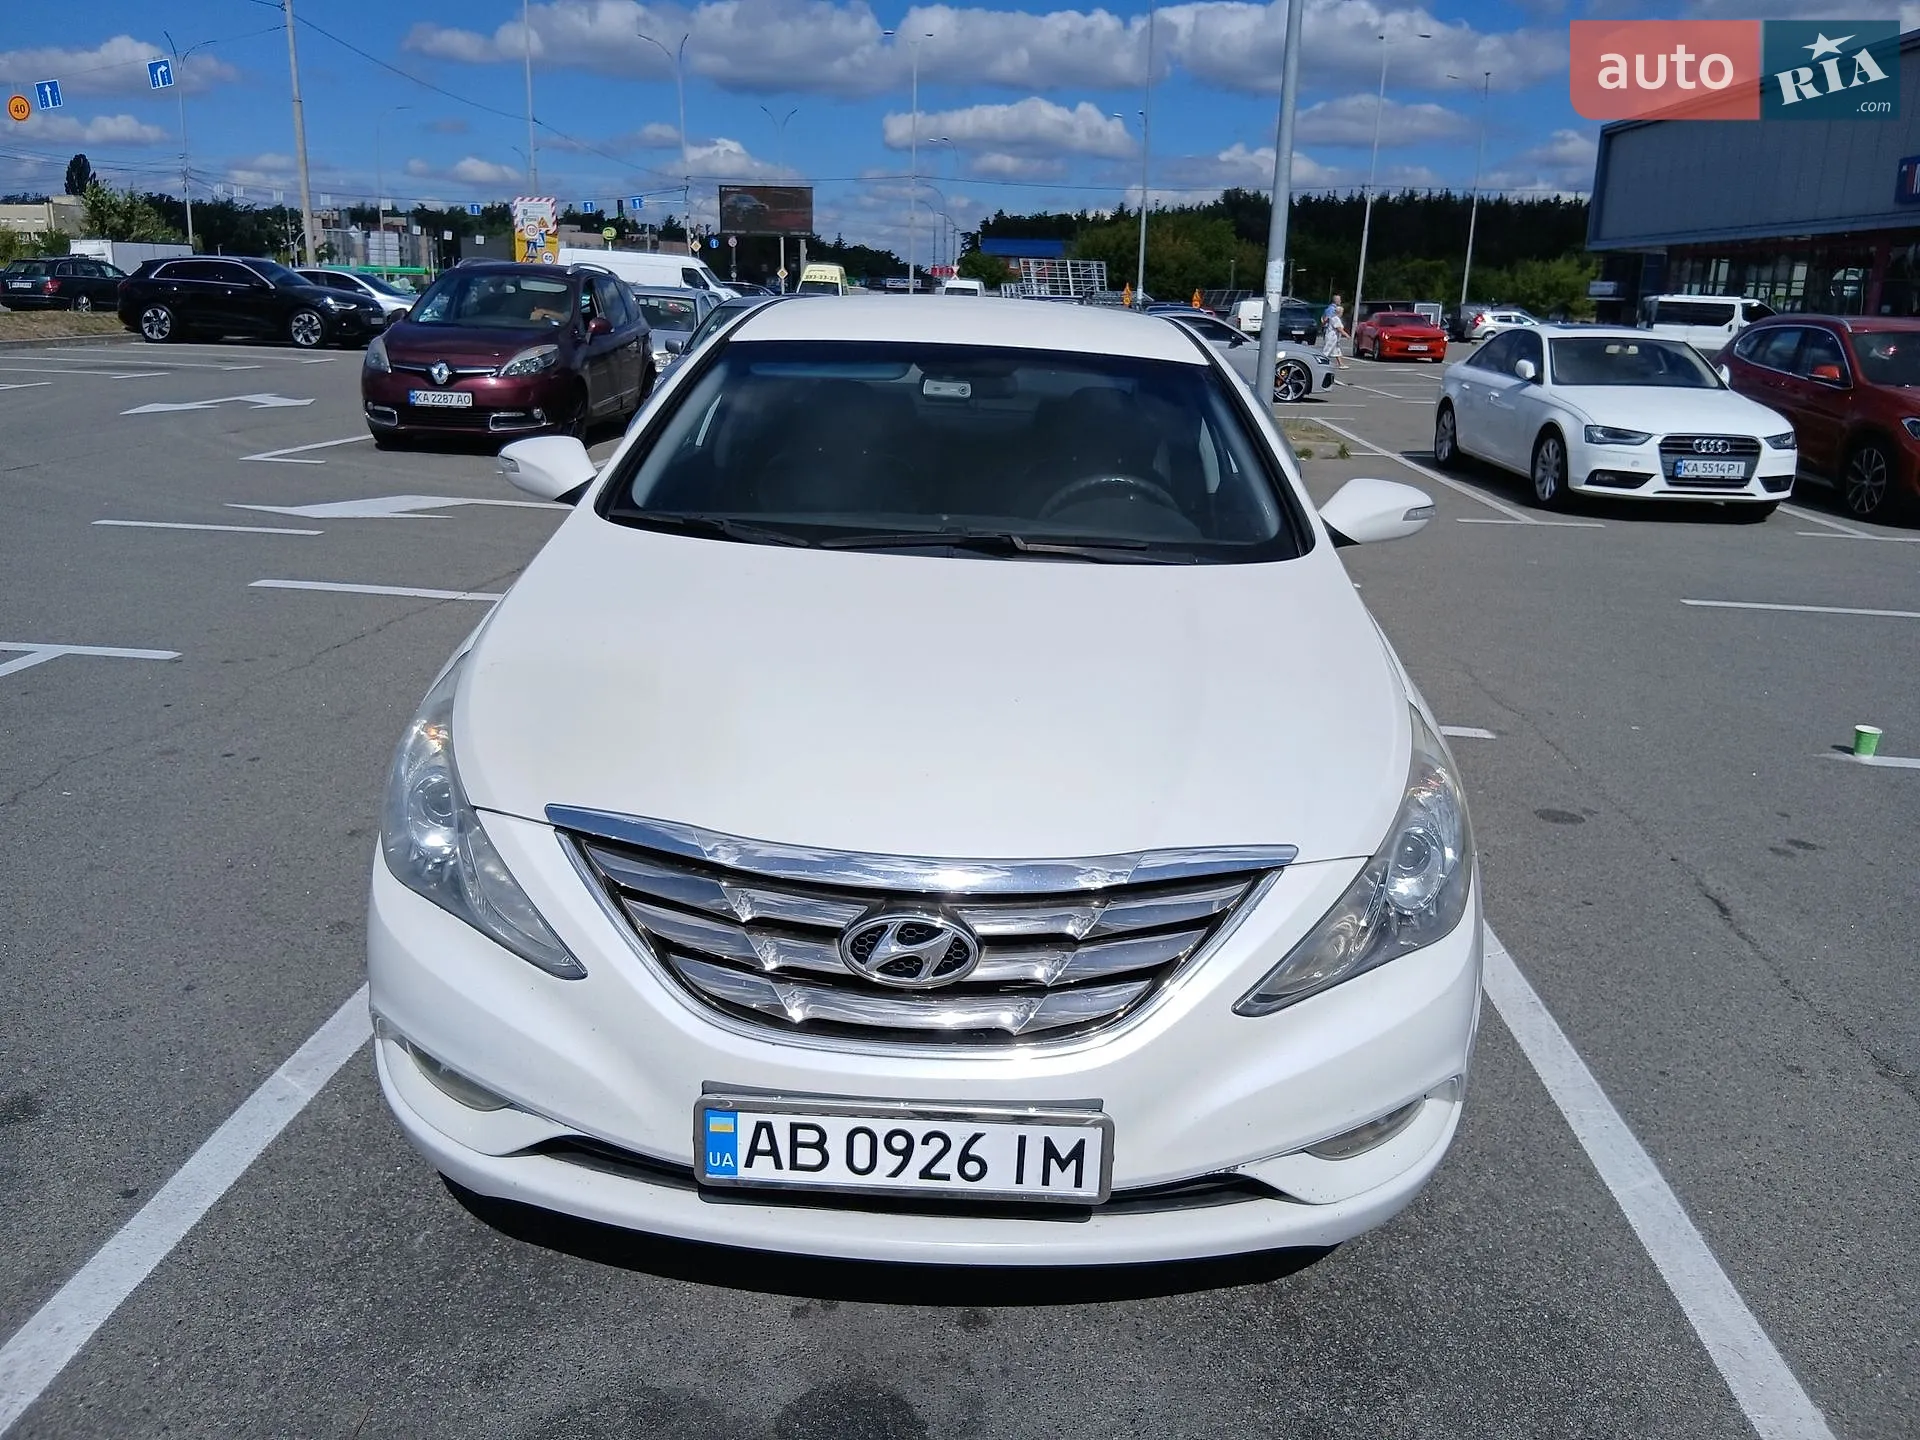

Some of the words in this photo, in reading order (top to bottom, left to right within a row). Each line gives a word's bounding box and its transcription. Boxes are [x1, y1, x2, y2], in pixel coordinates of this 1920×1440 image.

[14, 104, 26, 114] 40
[415, 393, 429, 403] KA
[431, 393, 454, 404] 2287
[457, 394, 471, 405] AO
[1683, 462, 1698, 473] KA
[1702, 462, 1726, 474] 5514
[1727, 464, 1740, 474] PI
[709, 1151, 735, 1168] UA
[744, 1120, 830, 1173] AB
[846, 1125, 989, 1183] 0926
[1015, 1134, 1086, 1189] IM
